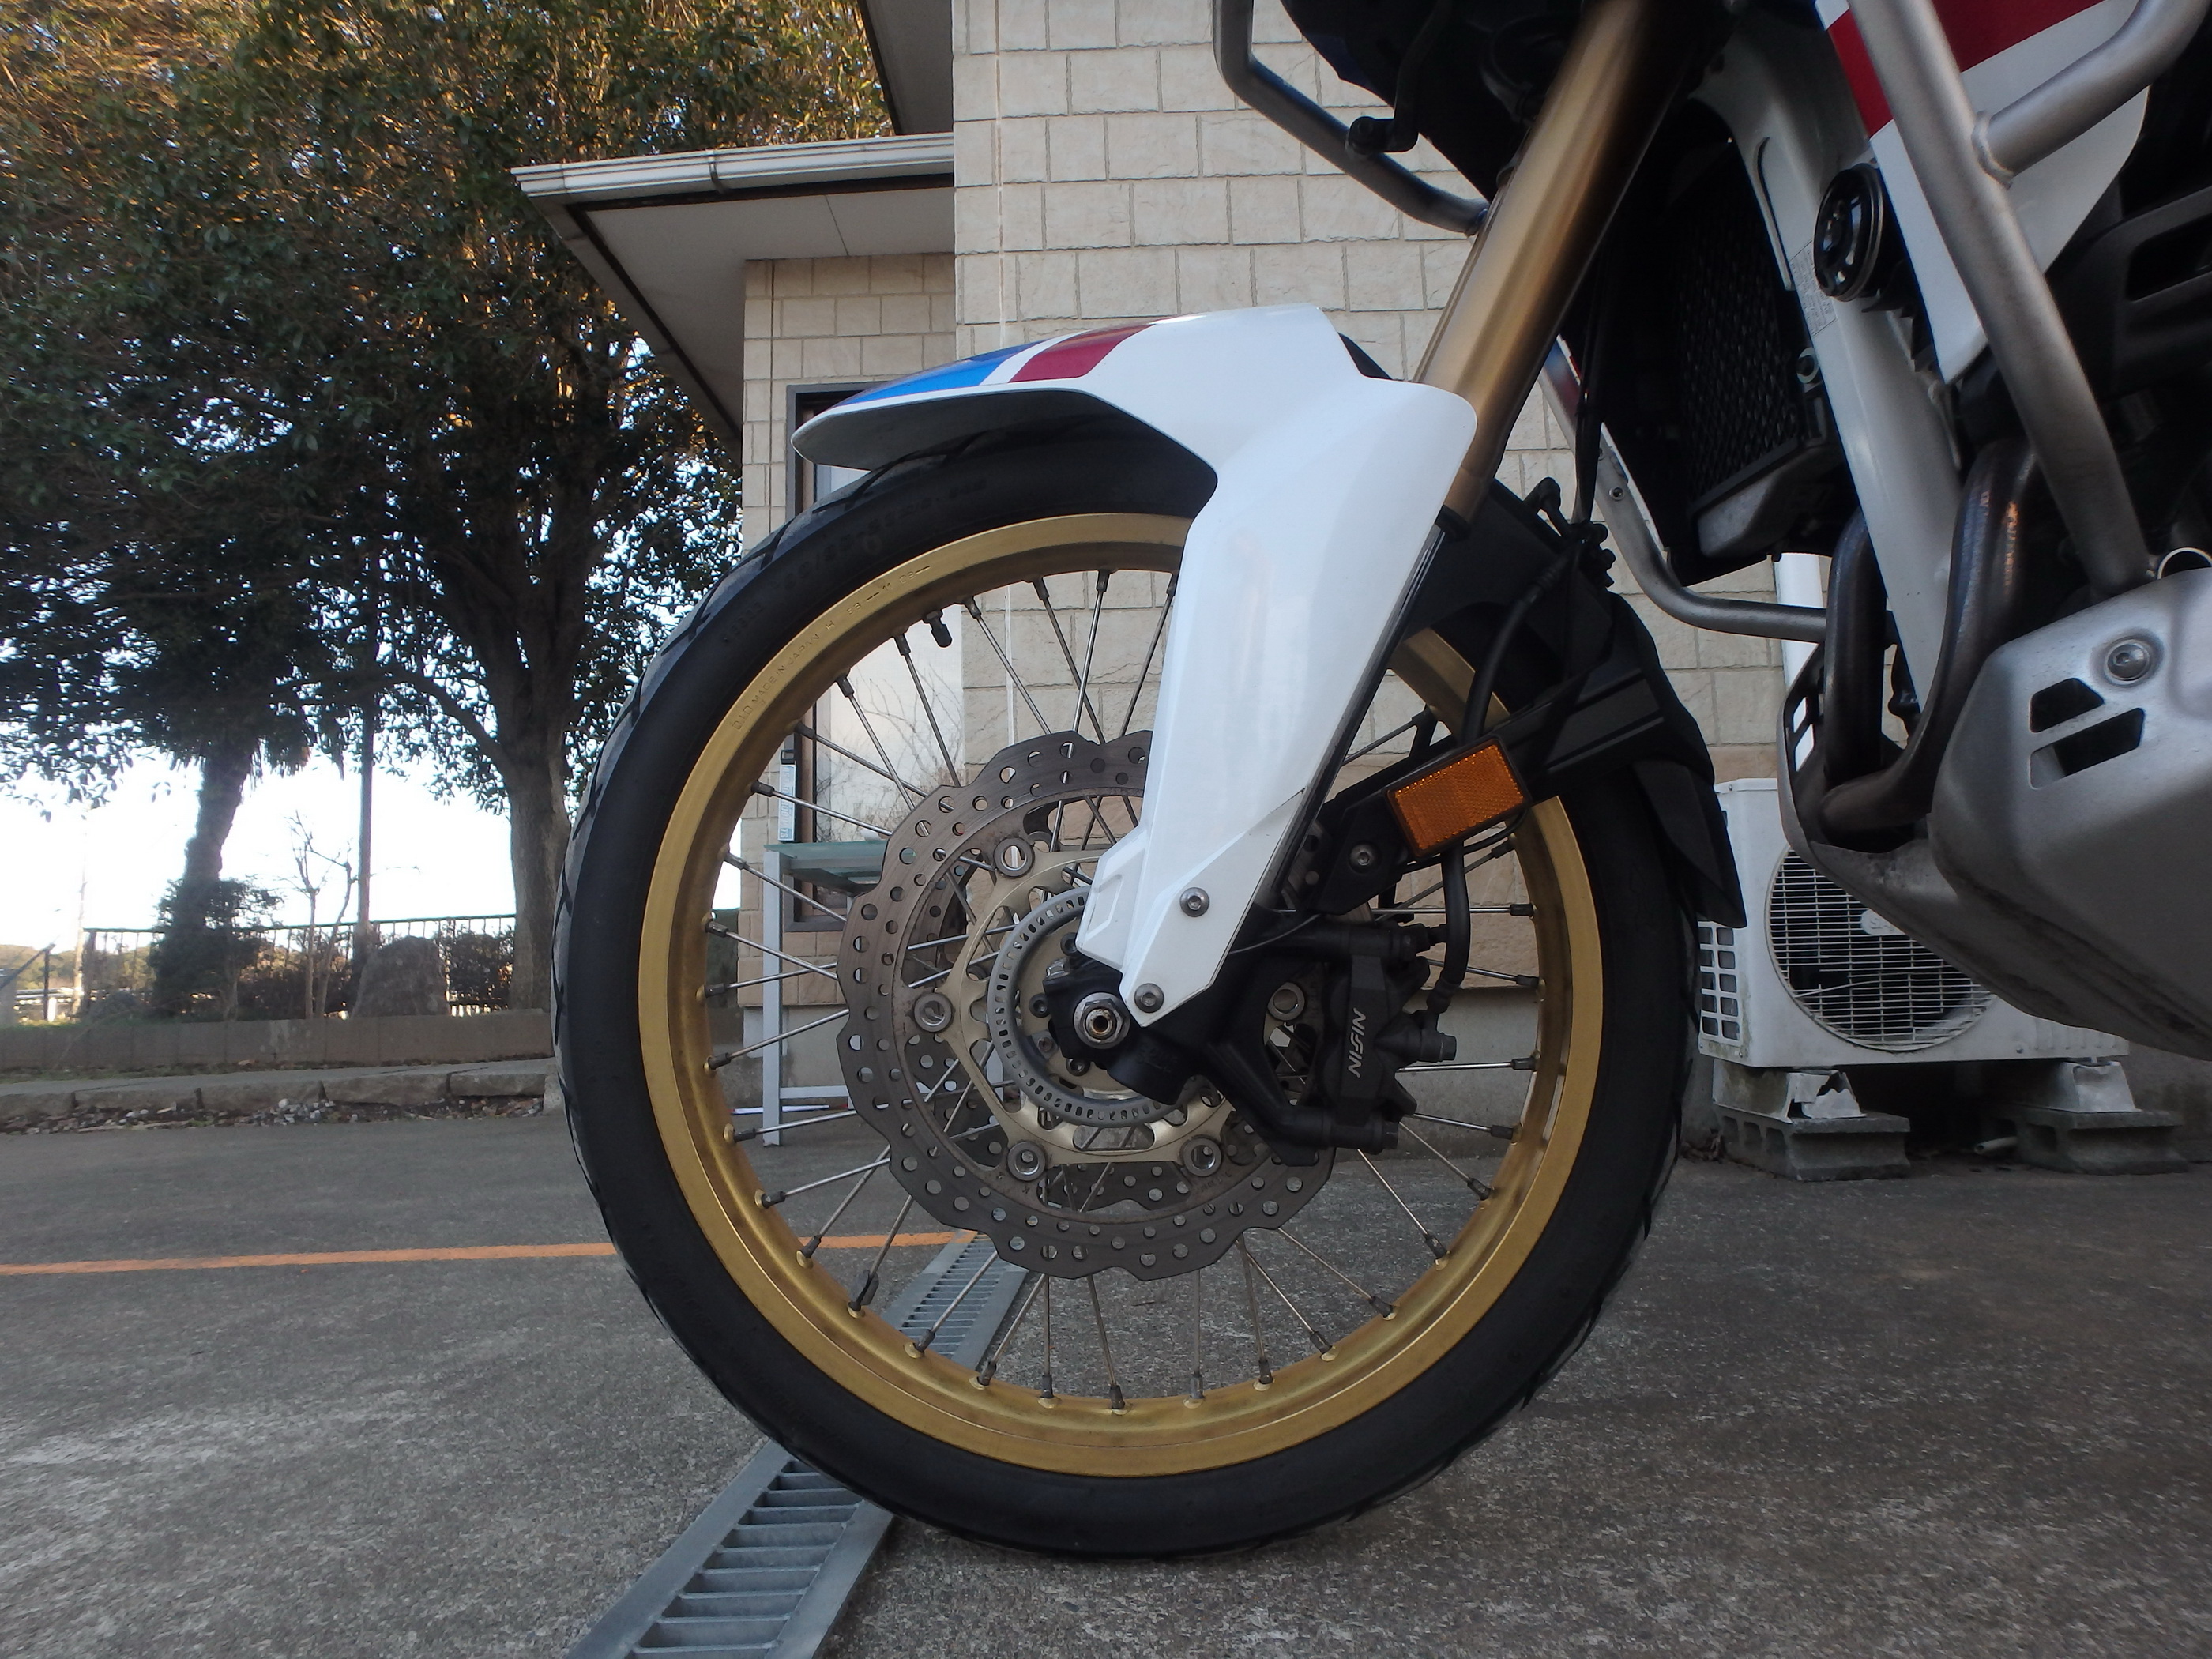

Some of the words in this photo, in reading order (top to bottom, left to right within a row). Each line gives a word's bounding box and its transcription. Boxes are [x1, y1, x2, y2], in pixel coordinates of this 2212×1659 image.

[751, 675, 777, 703] MADE
[776, 665, 786, 677] IN
[788, 633, 821, 666] JAPAN
